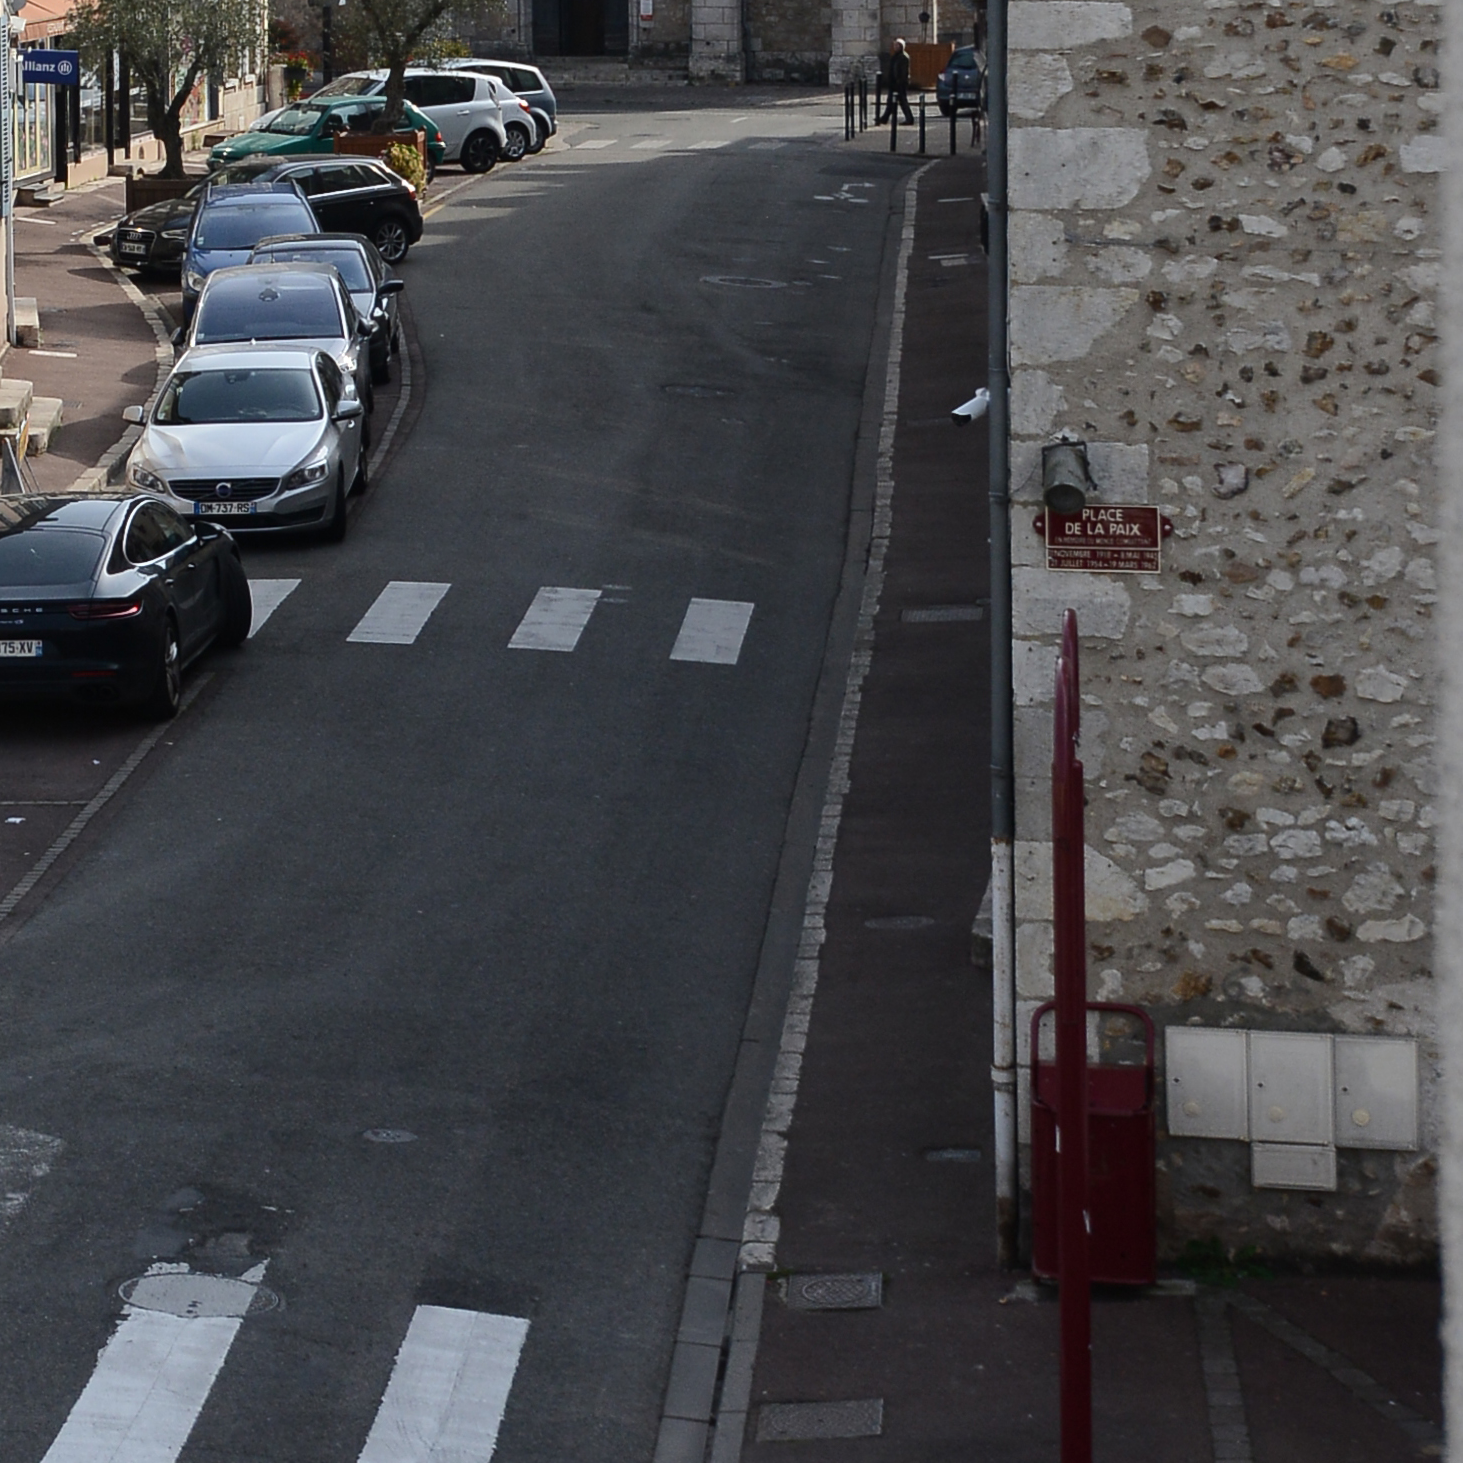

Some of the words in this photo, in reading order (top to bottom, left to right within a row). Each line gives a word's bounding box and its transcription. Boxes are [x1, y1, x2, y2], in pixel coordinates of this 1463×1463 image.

[1082, 508, 1124, 522] PLACE
[1065, 522, 1082, 535] DE
[1087, 522, 1105, 535] LA
[1109, 523, 1142, 536] PAIX
